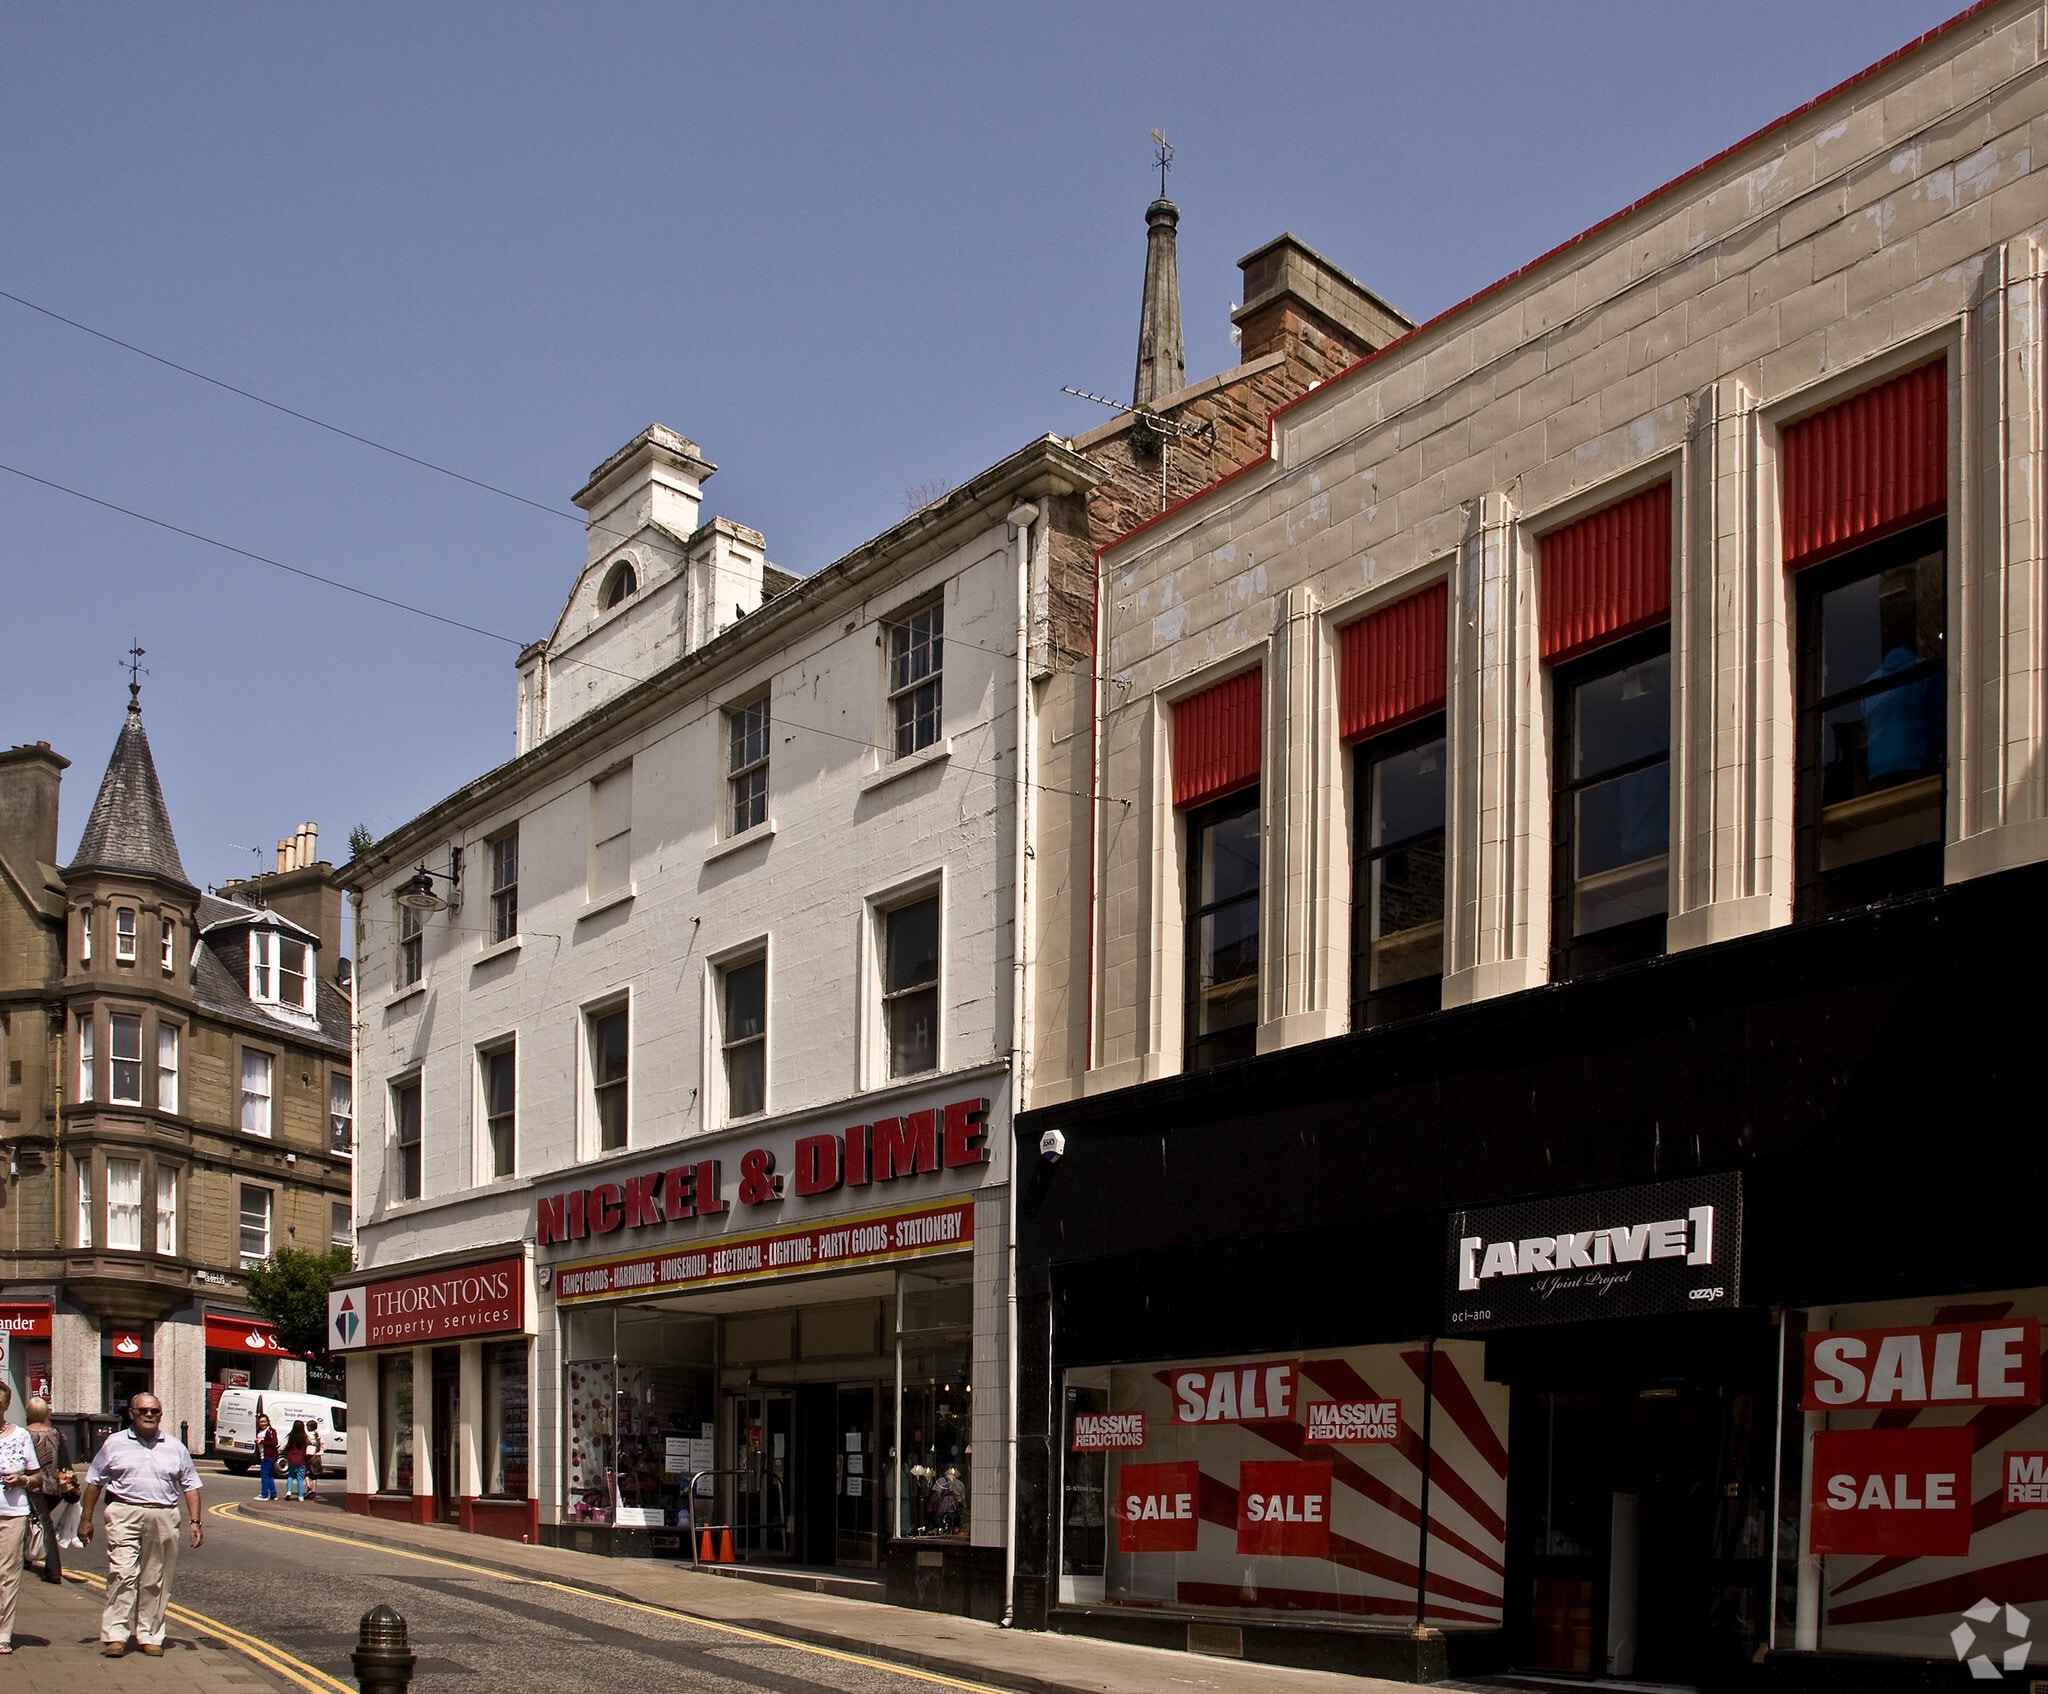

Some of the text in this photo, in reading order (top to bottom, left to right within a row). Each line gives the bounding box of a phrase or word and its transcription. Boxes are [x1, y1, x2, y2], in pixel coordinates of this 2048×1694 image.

[537, 1097, 990, 1246] NICKEL & DIME
[562, 1273, 584, 1295] FANCY
[584, 1269, 609, 1291] GOODS
[614, 1262, 655, 1288] HARDWARE
[660, 1254, 707, 1281] HOUSEHOLD
[713, 1244, 763, 1274] ELECTRICAL
[768, 1236, 812, 1266] LIGHTING
[819, 1230, 850, 1259] PARTY
[852, 1224, 888, 1254] GOODS
[896, 1212, 962, 1247] STATIONERY
[372, 1272, 509, 1317] THORNTONS
[1541, 1276, 1583, 1300] Joint
[1584, 1270, 1633, 1296] Project
[1689, 1285, 1724, 1301] ozzys
[372, 1308, 509, 1340] property services
[1813, 1326, 2025, 1405] SALE
[1176, 1366, 1291, 1423] SALE
[1075, 1414, 1143, 1434] MASSIVE
[1309, 1403, 1397, 1425] MASSIVE
[1075, 1433, 1143, 1447] REDUCTIONS
[1308, 1424, 1397, 1439] REDUCTIONS
[1126, 1493, 1193, 1521] SALE
[1826, 1473, 1956, 1511] SALE
[1246, 1494, 1323, 1522] SALE
